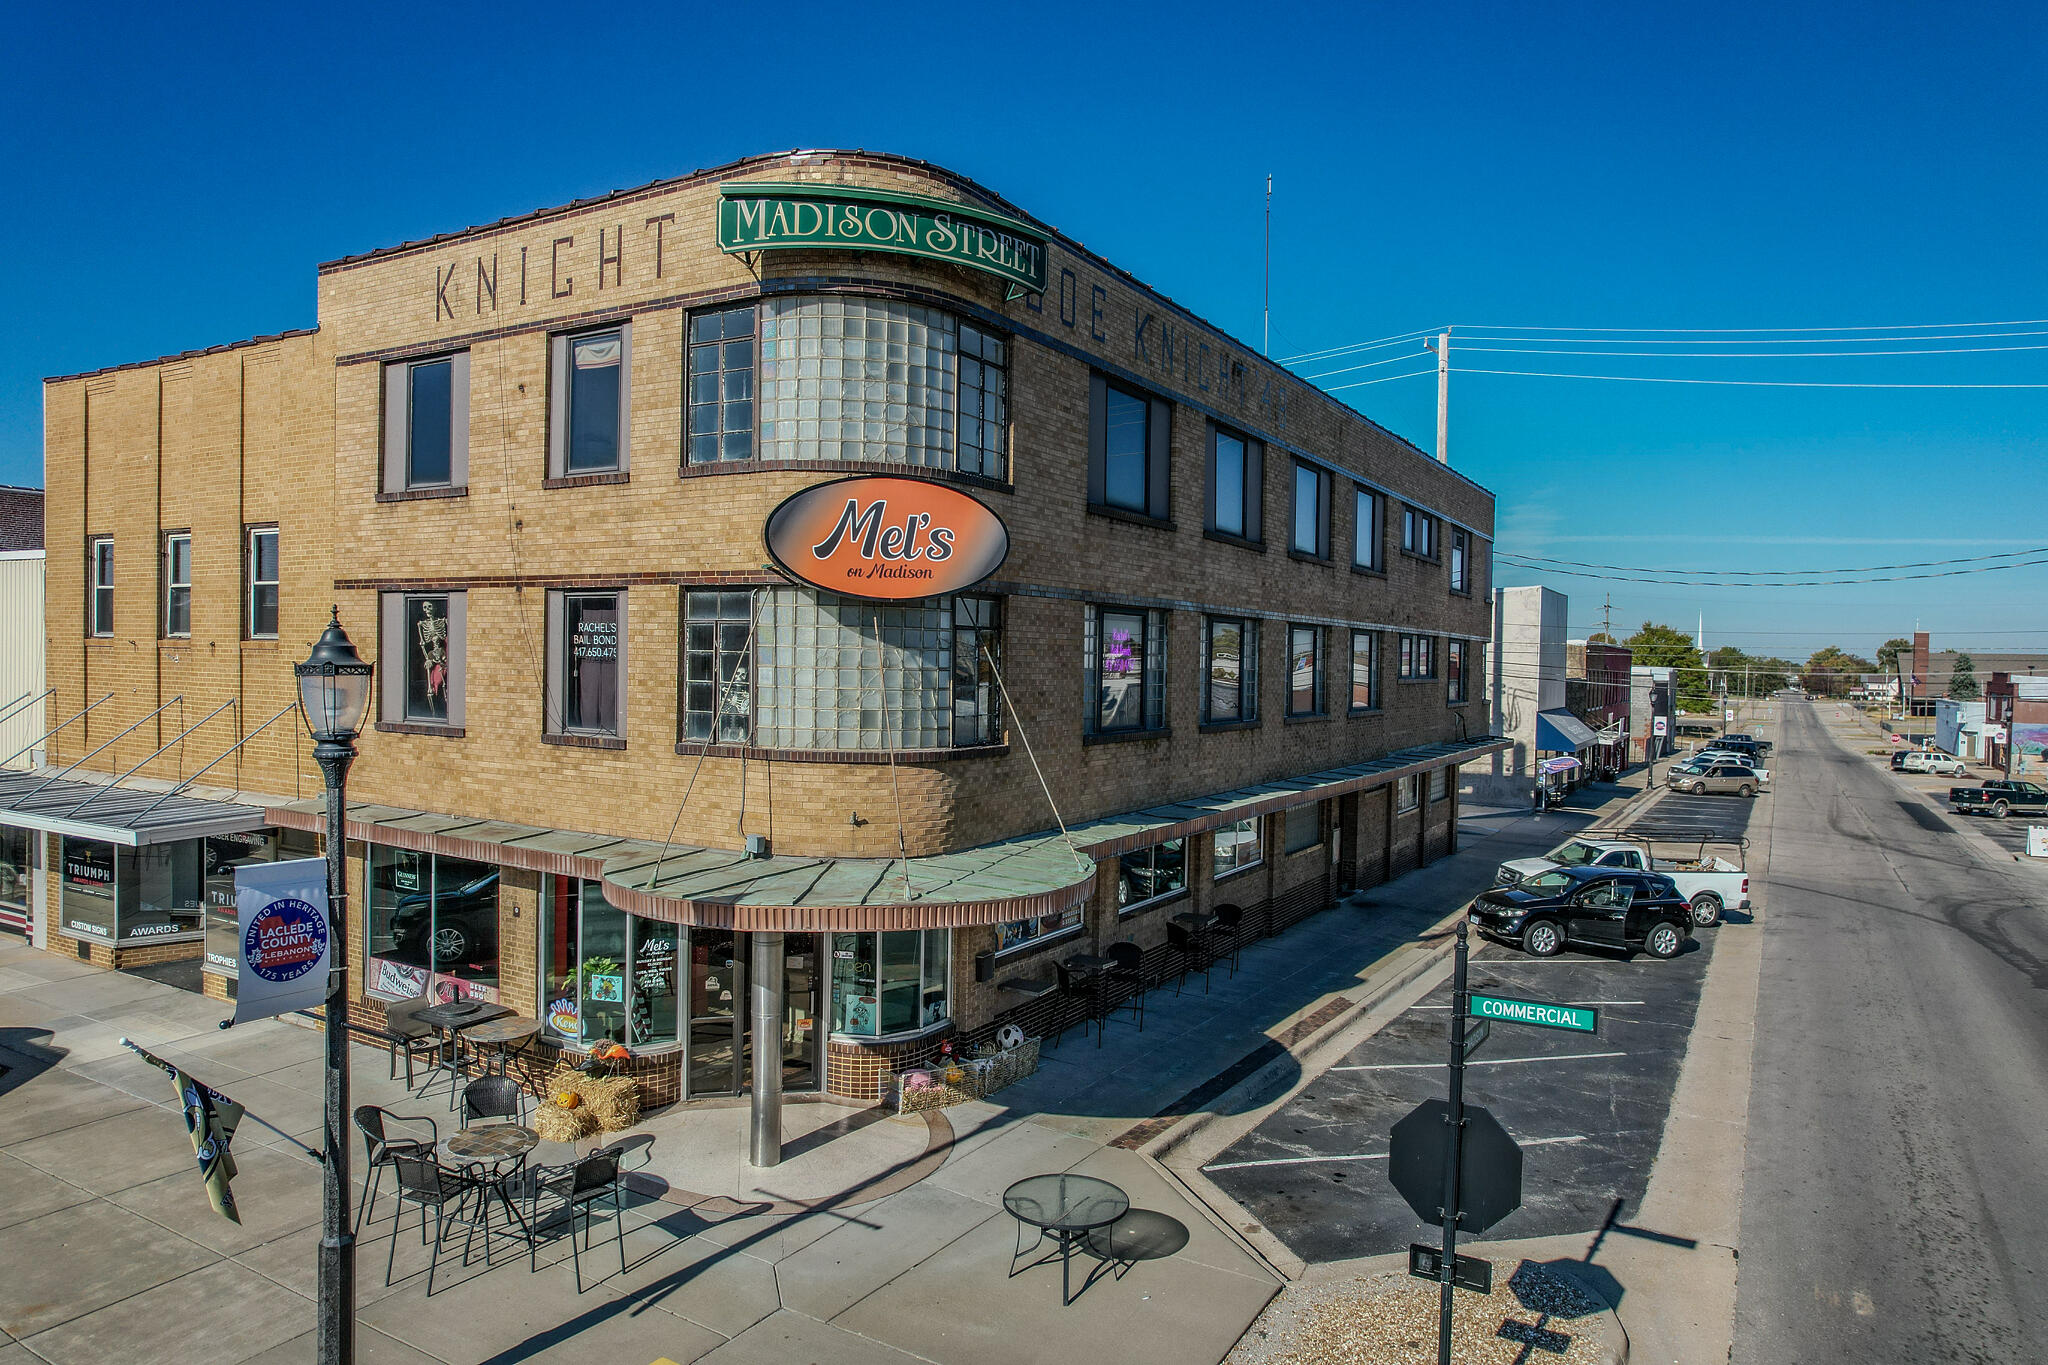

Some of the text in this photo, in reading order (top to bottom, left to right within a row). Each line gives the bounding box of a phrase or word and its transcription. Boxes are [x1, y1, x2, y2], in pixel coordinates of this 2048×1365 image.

[733, 199, 1040, 279] MADISON STREET
[436, 213, 676, 322] KNIGHT
[812, 499, 956, 562] Mel's
[847, 563, 934, 579] on Madison
[578, 622, 616, 633] RACHEL'S
[573, 634, 592, 645] BAIL
[210, 833, 230, 841] ASER
[68, 862, 110, 881] TRIUMPH
[211, 890, 237, 907] TRIU
[71, 920, 108, 936] CUSTOM SIGNS
[130, 924, 179, 937] AWARDS
[247, 900, 326, 945] UNITED IN HERITAGE
[260, 922, 314, 939] LACLEDE
[261, 932, 313, 949] COUNTY
[639, 938, 670, 953] Mel's
[207, 952, 237, 967] TROPHIES
[264, 946, 311, 959] LEBANON
[260, 959, 314, 980] 175 YEARS
[1483, 1000, 1581, 1027] COMMERCIAL
